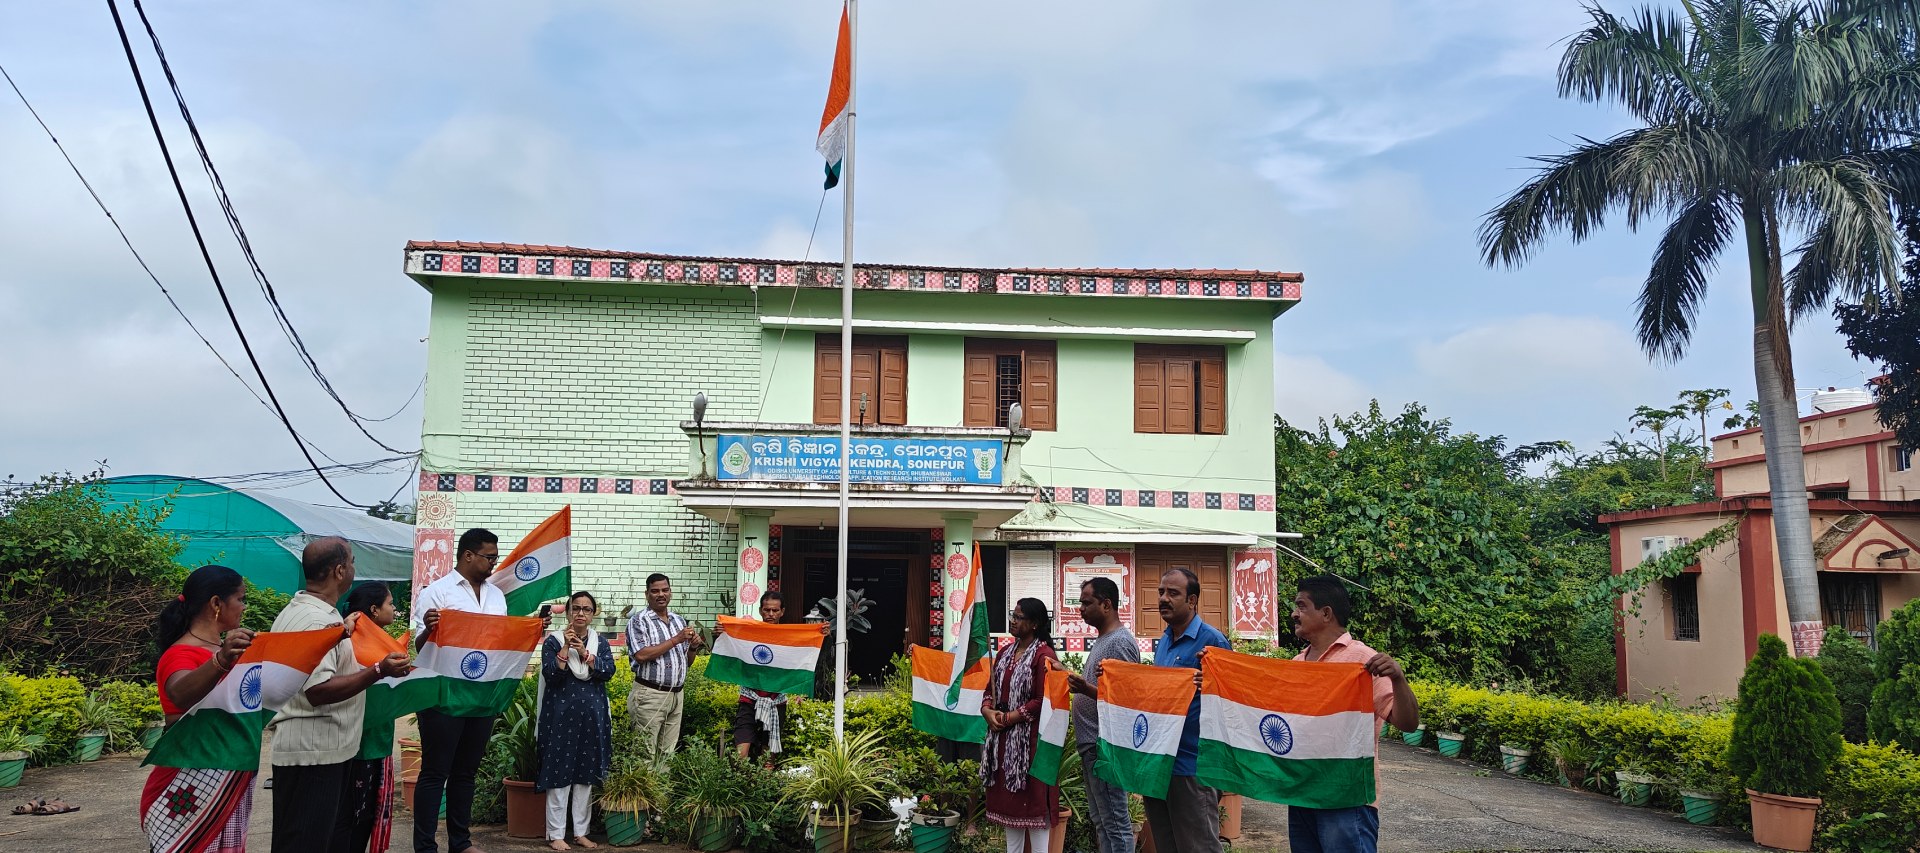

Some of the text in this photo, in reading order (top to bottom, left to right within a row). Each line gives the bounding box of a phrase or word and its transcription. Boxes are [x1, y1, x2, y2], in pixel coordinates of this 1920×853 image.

[752, 439, 782, 456] କୃଷି
[788, 439, 837, 455] ବିଜ୍ଞାନ
[893, 445, 968, 460] ସୋନପୁର
[754, 457, 797, 467] KRISHI
[850, 459, 904, 470] KENDRA,
[907, 460, 965, 470] SONEPUR
